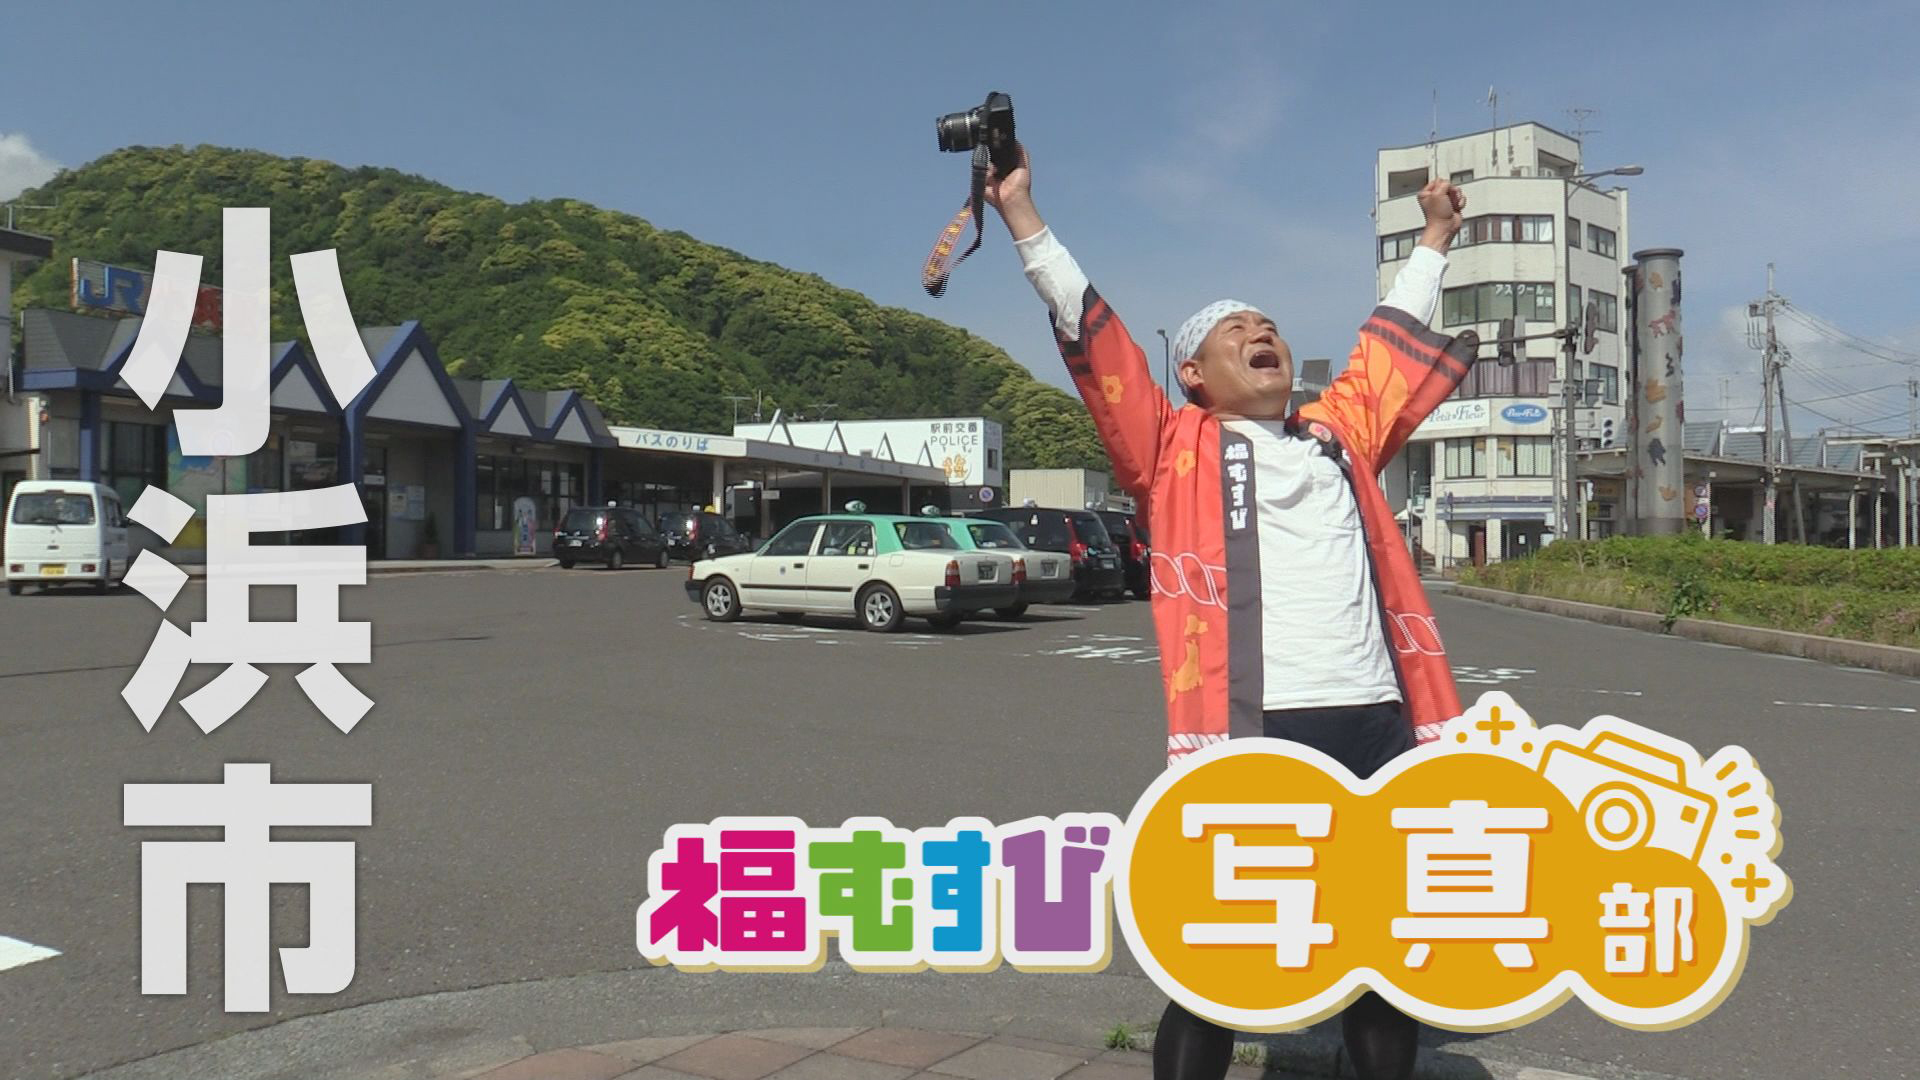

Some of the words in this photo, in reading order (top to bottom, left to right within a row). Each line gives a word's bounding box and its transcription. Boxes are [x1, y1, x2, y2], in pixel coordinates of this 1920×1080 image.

[80, 263, 144, 314] JR
[930, 422, 977, 434] 駅前交番
[635, 432, 709, 452] バスのりば
[930, 435, 978, 446] POLICE
[1225, 443, 1249, 530] 福むすび
